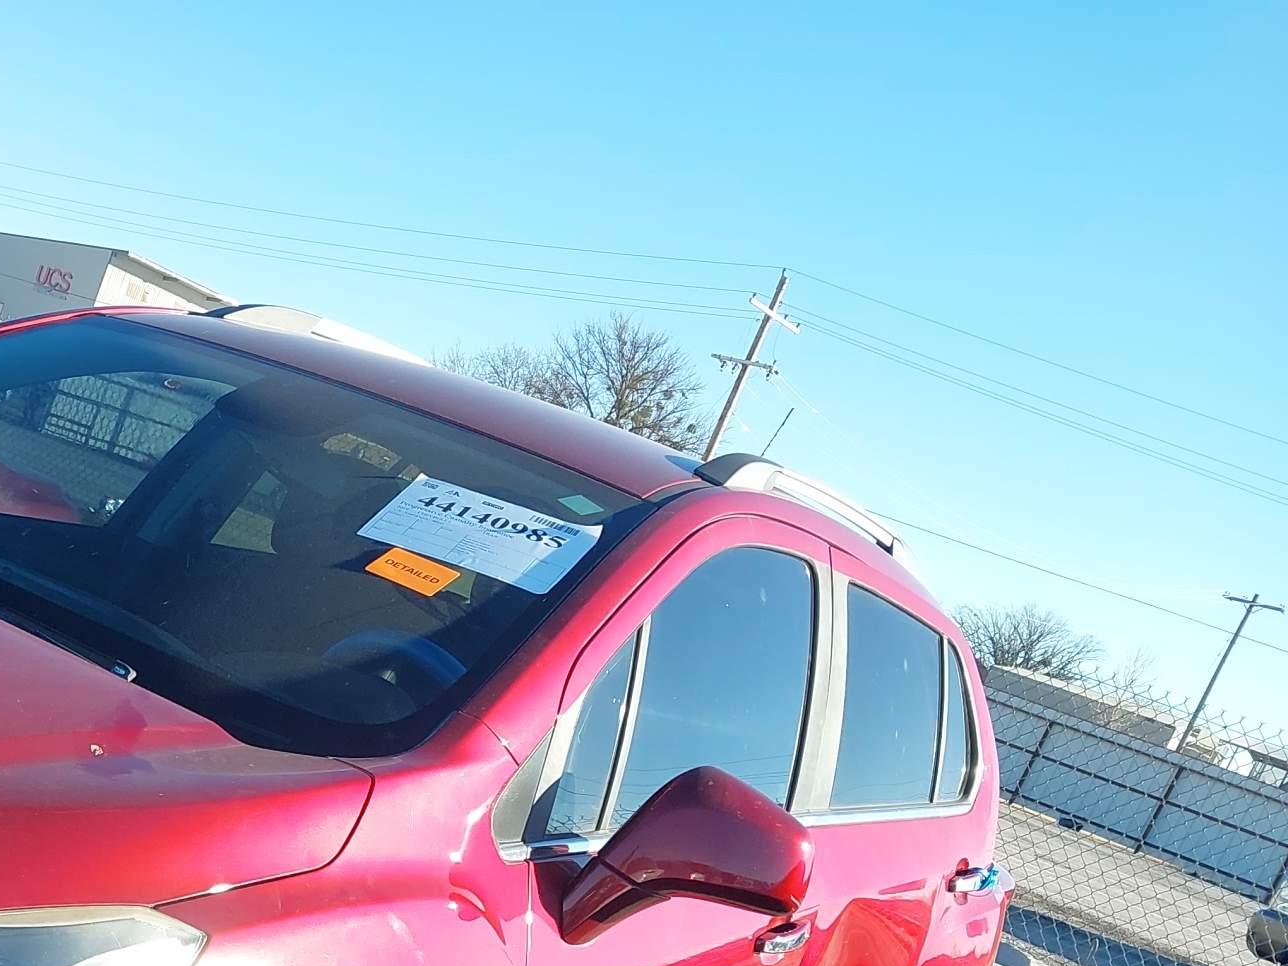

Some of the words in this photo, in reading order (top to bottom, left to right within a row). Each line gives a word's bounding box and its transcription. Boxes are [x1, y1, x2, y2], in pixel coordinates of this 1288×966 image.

[36, 264, 73, 292] UCS
[417, 495, 564, 549] 44140985
[384, 558, 440, 585] DETAILED
